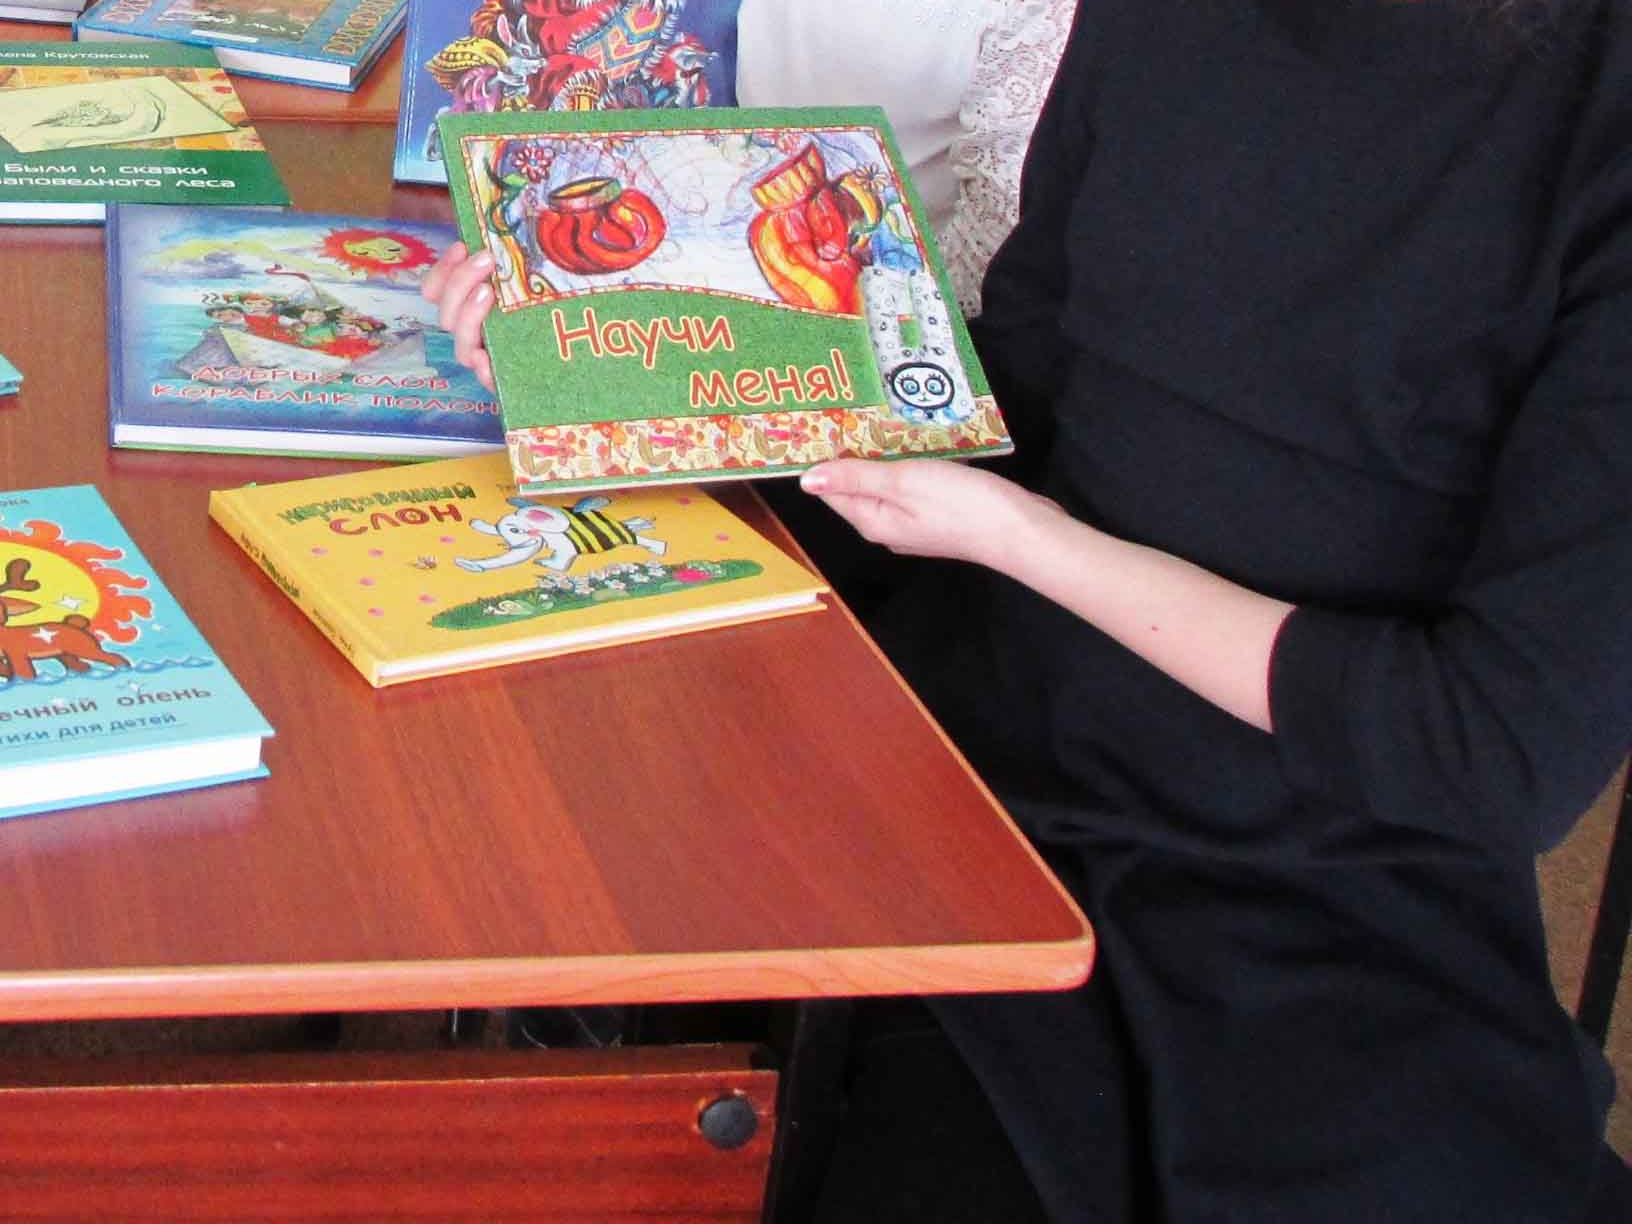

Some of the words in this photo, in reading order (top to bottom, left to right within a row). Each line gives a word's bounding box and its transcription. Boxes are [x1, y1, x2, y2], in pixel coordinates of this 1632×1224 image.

[44, 50, 151, 61] Крутовская
[3, 162, 78, 175] Были
[89, 165, 107, 175] и
[118, 165, 209, 176] сказки
[175, 178, 236, 189] леса
[551, 308, 737, 370] Научи
[192, 365, 345, 385] ДОБРЫХ
[354, 374, 450, 392] СЛОВ
[688, 349, 855, 410] меня!
[151, 382, 360, 406] КОРАБЛИК
[371, 393, 500, 417] ПОЛОН
[329, 503, 463, 536] СЛОН
[116, 686, 212, 708] олень
[58, 723, 105, 740] для
[109, 713, 177, 731] детей
